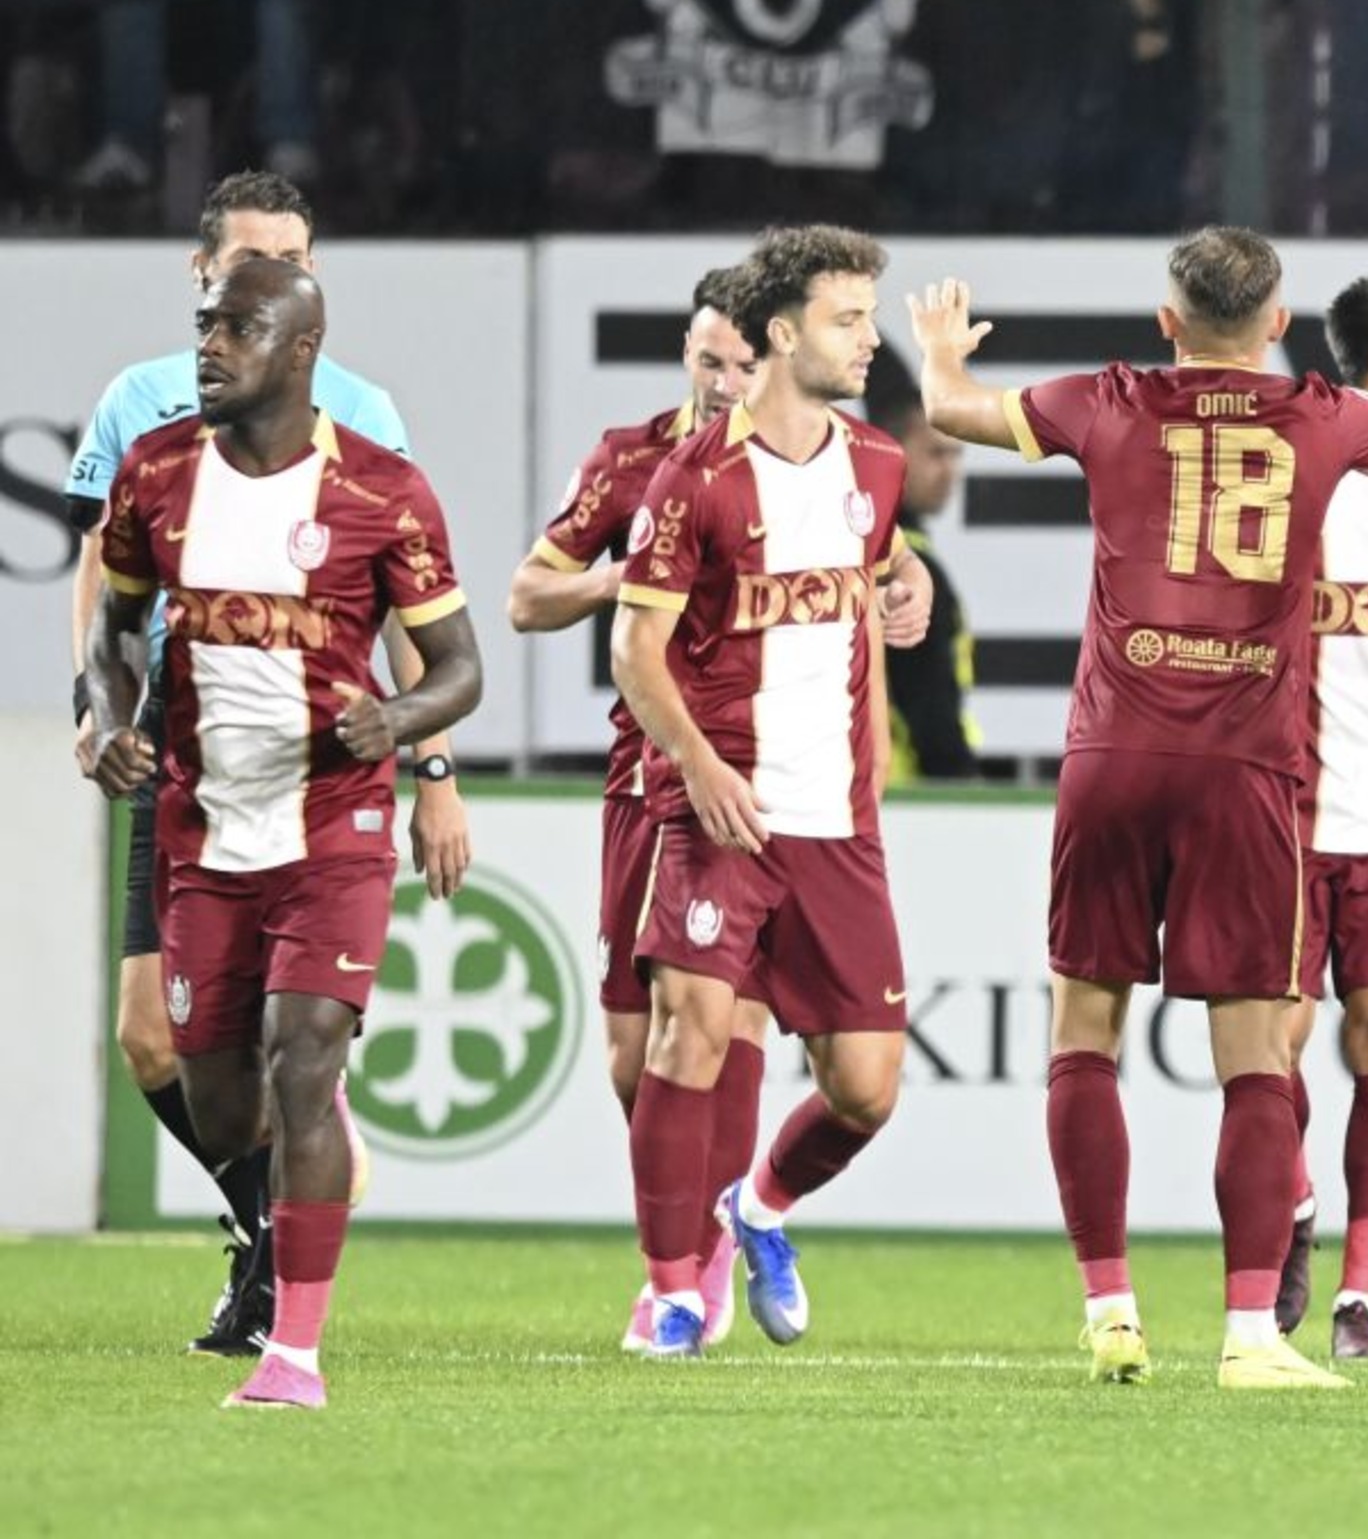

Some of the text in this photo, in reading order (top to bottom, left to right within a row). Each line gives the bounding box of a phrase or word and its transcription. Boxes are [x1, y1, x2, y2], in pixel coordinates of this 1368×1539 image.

[572, 469, 613, 530] DSC
[652, 497, 688, 556] DSC
[1161, 423, 1296, 584] 18
[1167, 634, 1227, 657] Roata
